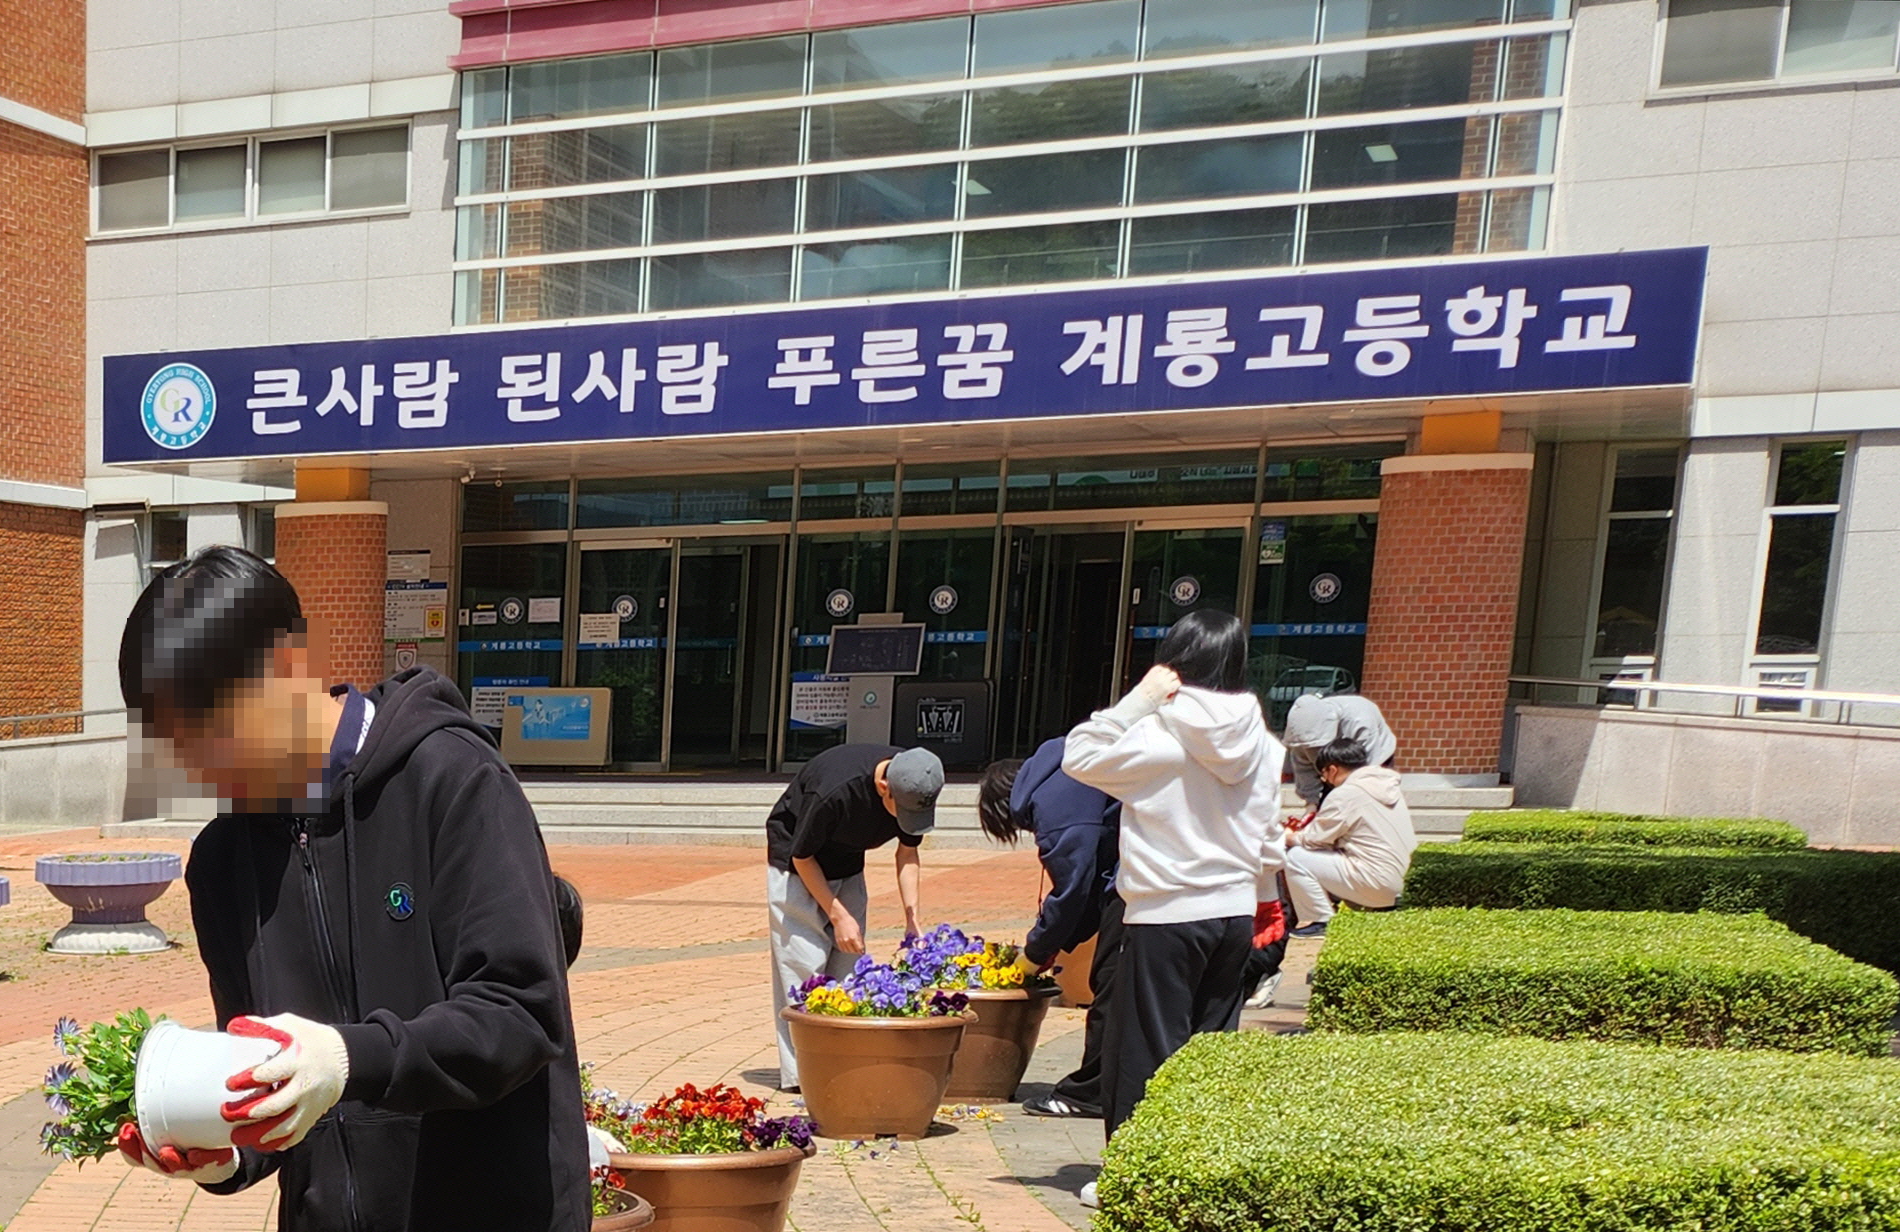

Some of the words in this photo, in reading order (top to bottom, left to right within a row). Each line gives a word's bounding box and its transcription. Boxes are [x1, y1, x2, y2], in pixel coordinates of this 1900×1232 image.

[246, 359, 460, 435] 큰사람
[497, 340, 729, 422] 된사람
[766, 322, 1014, 406] 푸른꿈
[1060, 284, 1637, 388] 계룡고등학교
